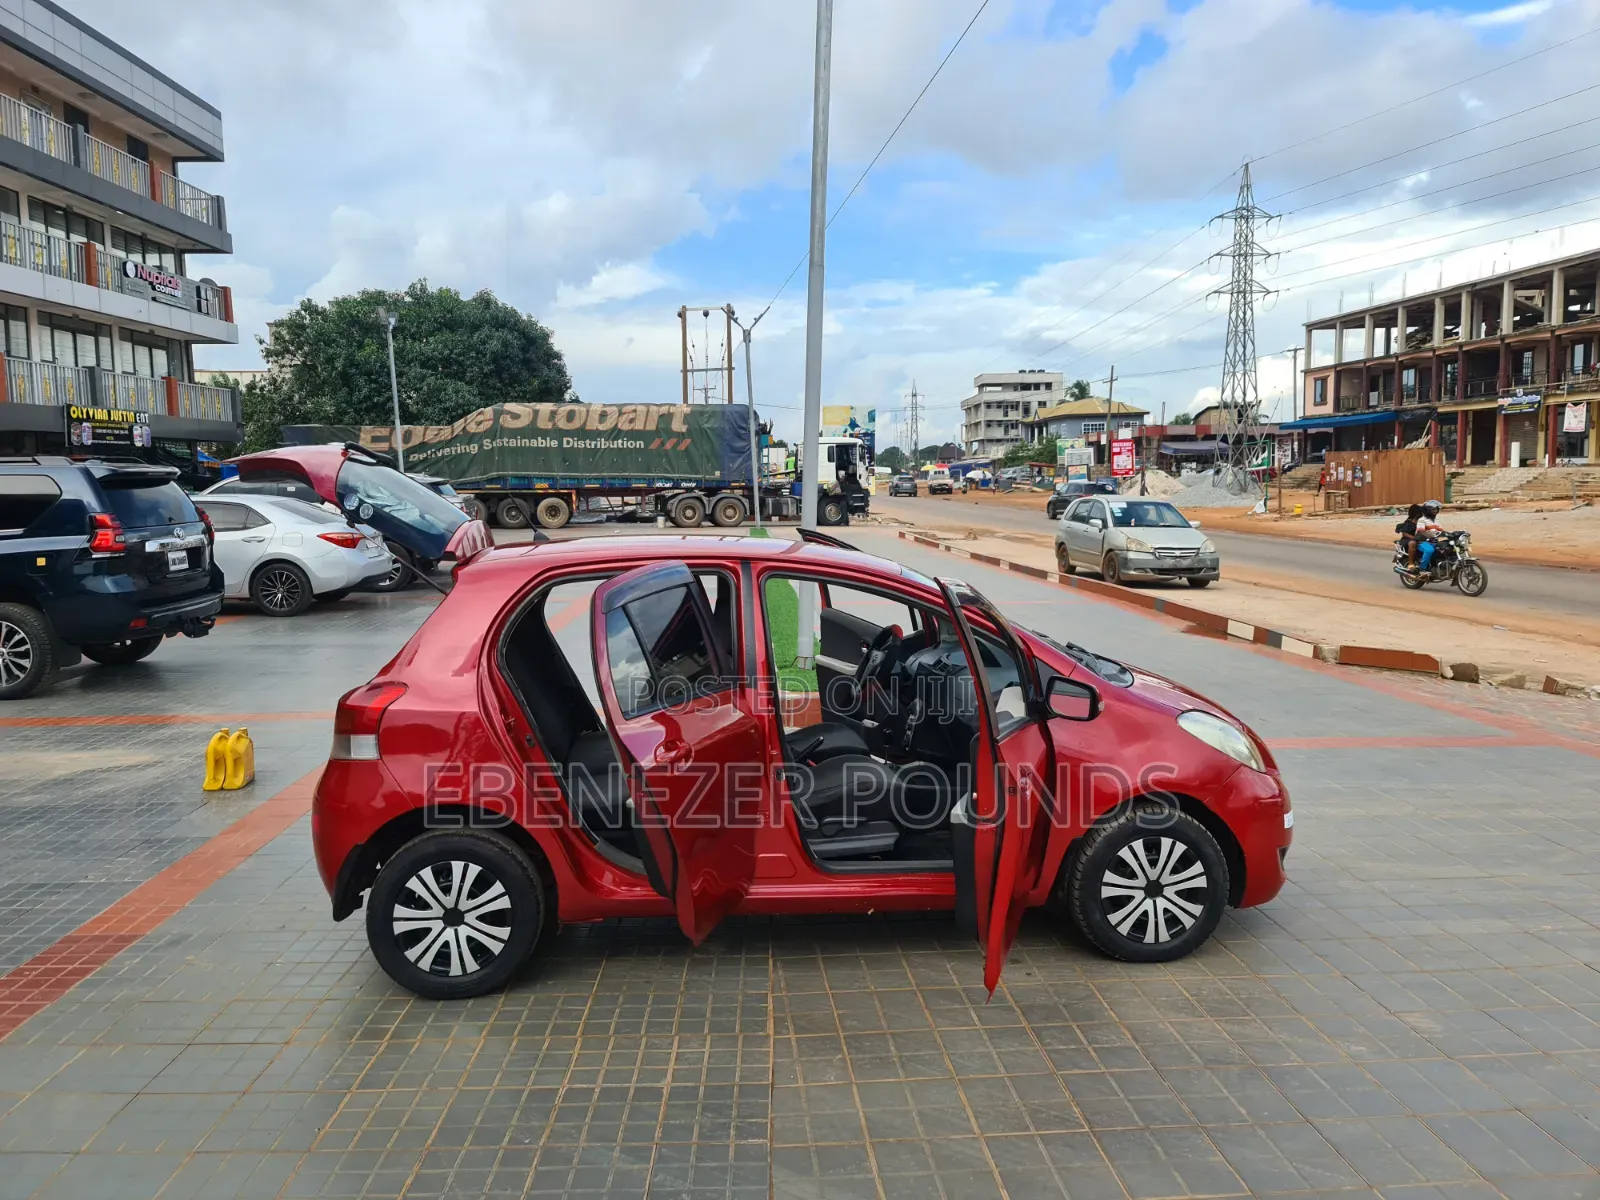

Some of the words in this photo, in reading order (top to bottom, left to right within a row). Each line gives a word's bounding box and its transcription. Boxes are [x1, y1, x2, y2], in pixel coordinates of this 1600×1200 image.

[137, 264, 182, 290] Nuptials
[500, 402, 692, 433] Stobart
[408, 443, 479, 462] Delivering
[562, 436, 645, 450] Distribution
